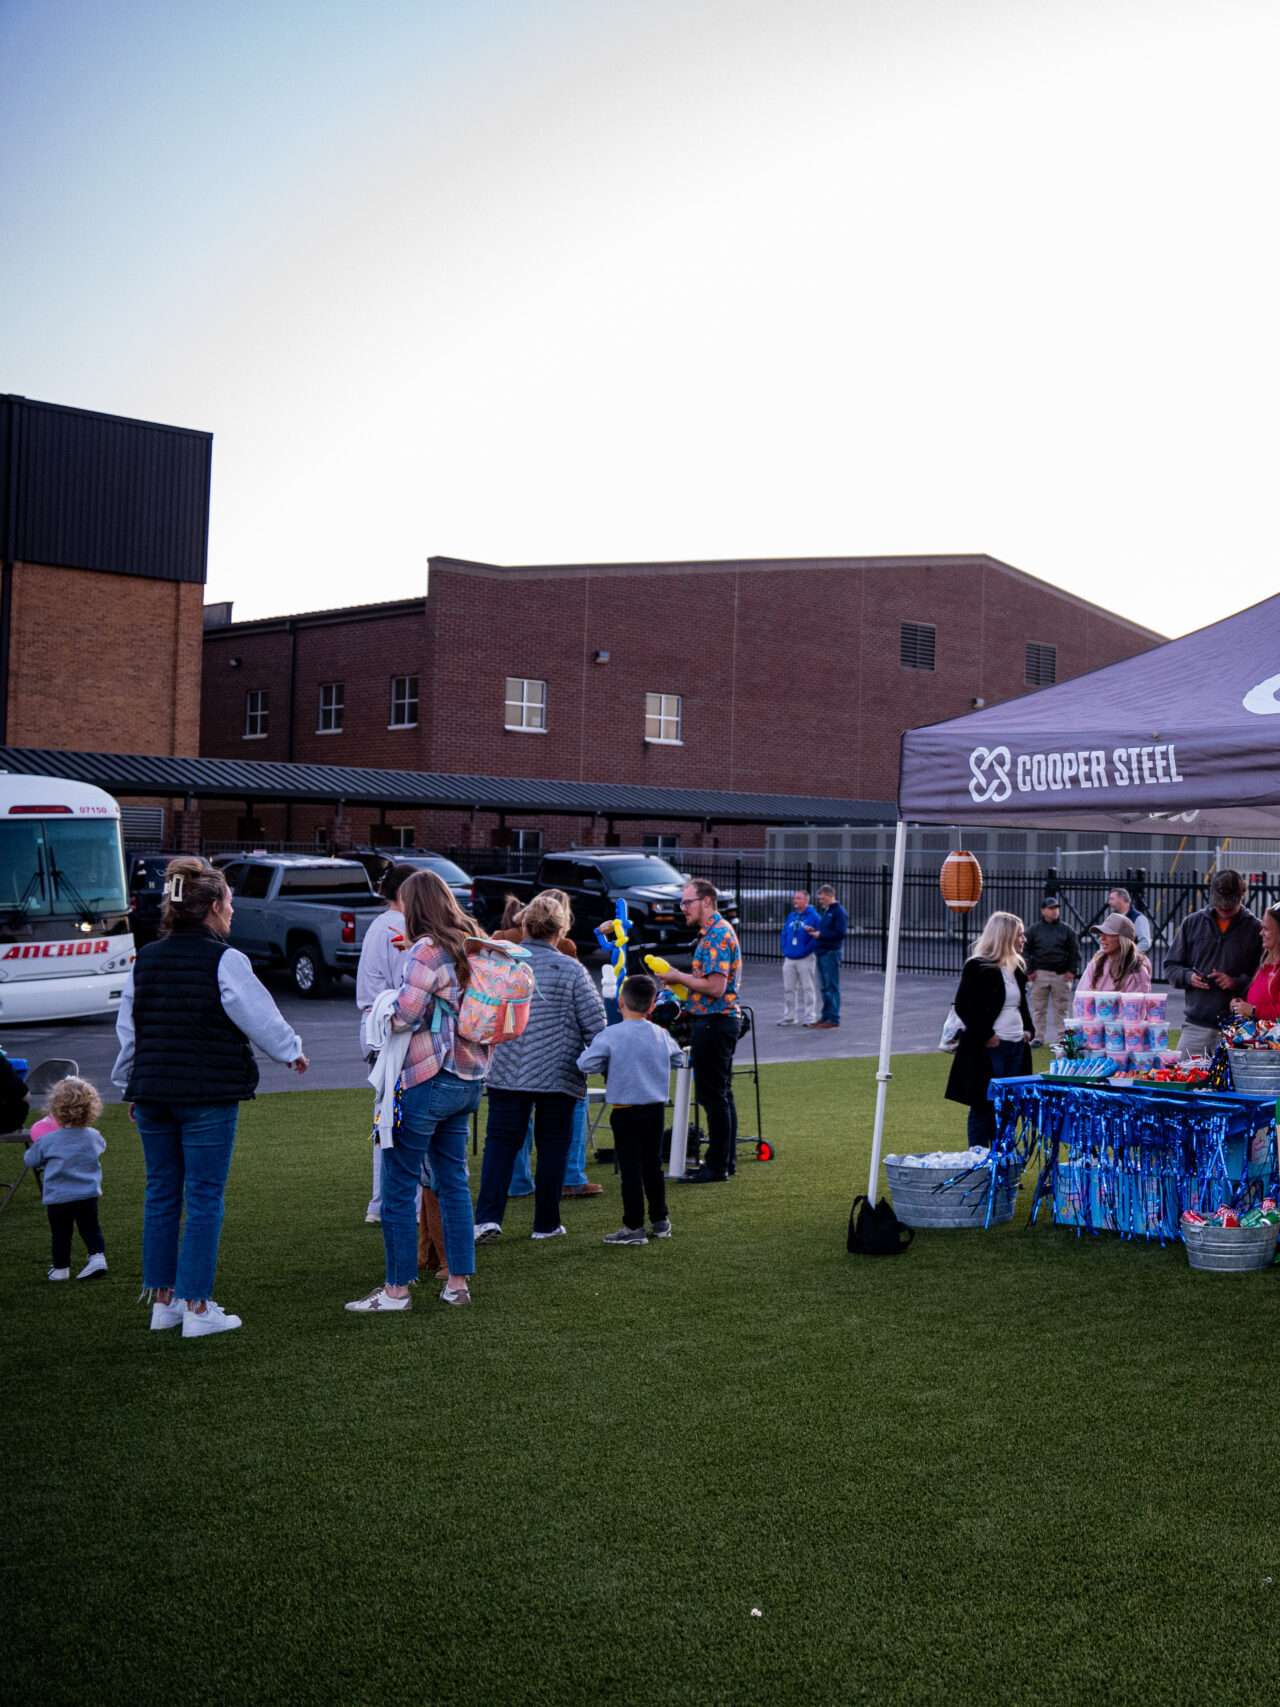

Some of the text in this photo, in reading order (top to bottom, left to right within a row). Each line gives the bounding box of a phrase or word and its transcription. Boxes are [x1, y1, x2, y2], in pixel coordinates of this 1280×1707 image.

[1017, 744, 1184, 792] COOPER STEEL
[2, 940, 109, 960] ANCHOR
